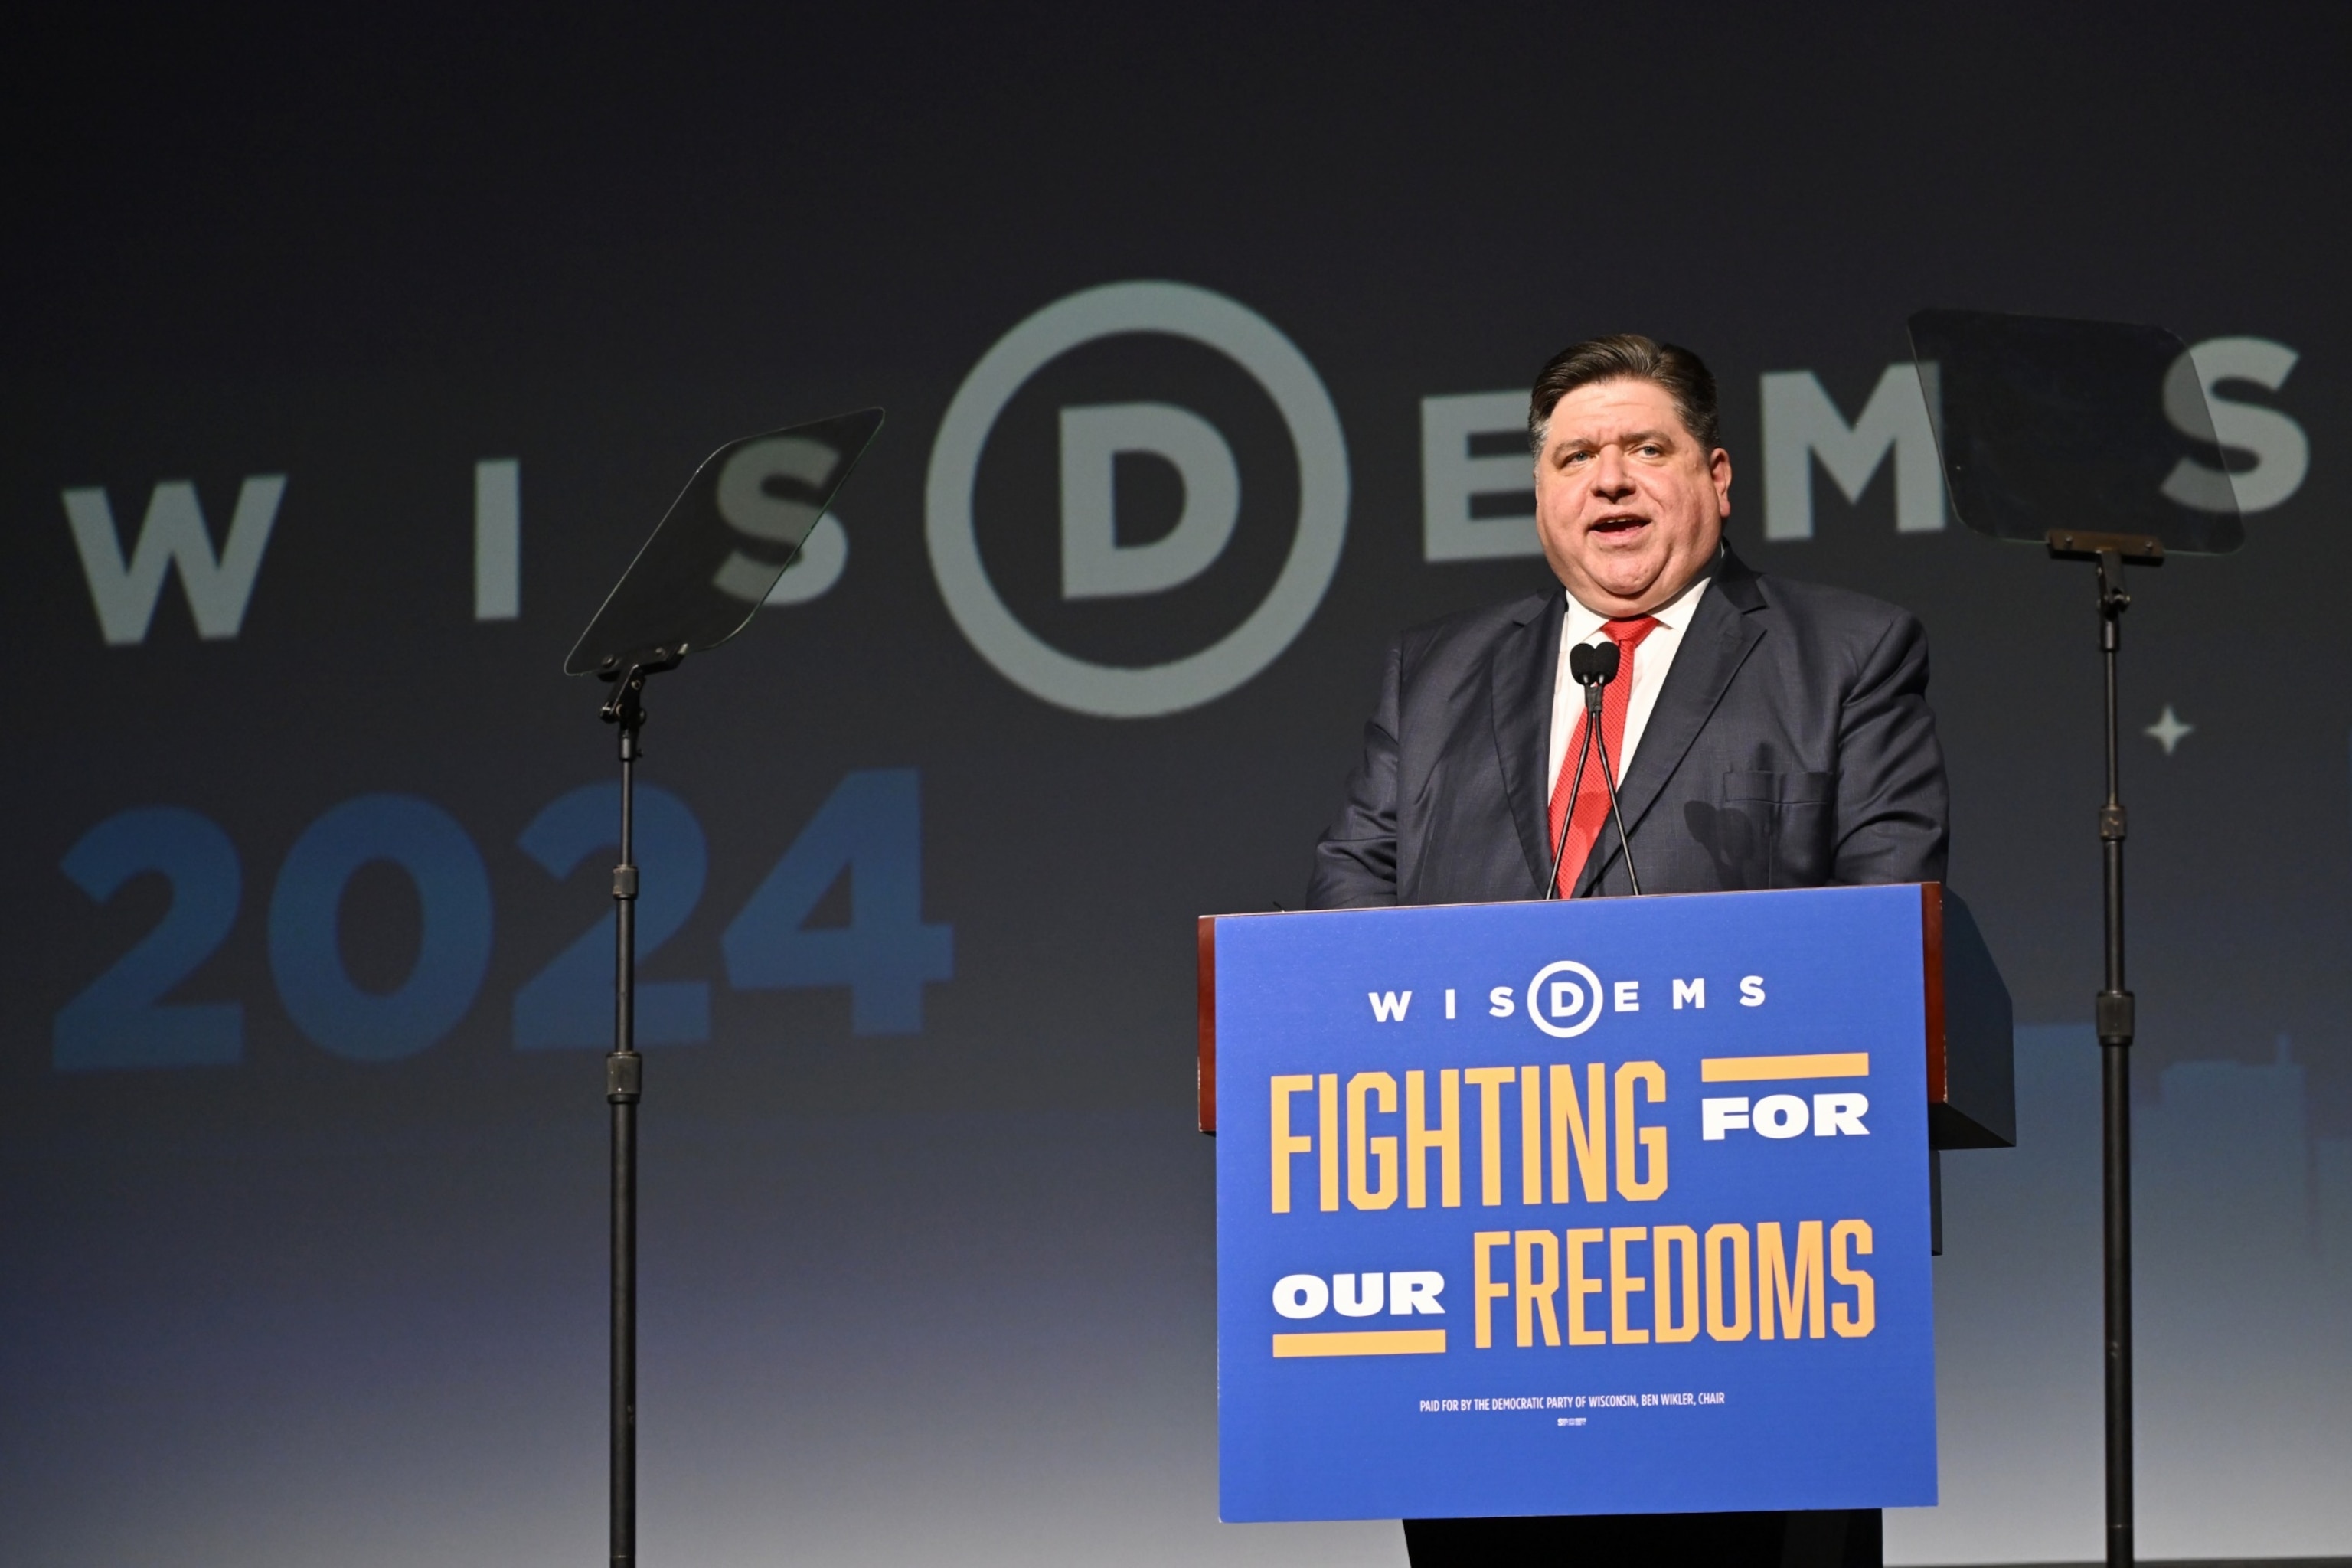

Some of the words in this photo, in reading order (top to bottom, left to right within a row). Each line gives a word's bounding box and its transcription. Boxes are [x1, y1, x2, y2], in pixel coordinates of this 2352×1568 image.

[61, 335, 2311, 646] WISDEMS
[52, 766, 955, 1070] 2024
[1368, 975, 1766, 1023] WISDEMS
[1270, 1060, 1668, 1214] FIGHTING
[1701, 1093, 1870, 1141] FOR
[1272, 1270, 1446, 1319] OUR
[1473, 1219, 1876, 1349] FREEDOMS
[1419, 1400, 1440, 1412] PAID
[1442, 1399, 1459, 1412] FOR
[1460, 1399, 1472, 1411] BY
[1473, 1398, 1490, 1411] THE
[1491, 1396, 1544, 1410] DEMOCRATIC
[1546, 1396, 1573, 1409] PARTY
[1575, 1396, 1586, 1408] OF
[1588, 1394, 1639, 1408] WISCONSIN,
[1641, 1393, 1659, 1406] BEN
[1660, 1393, 1697, 1406] WIKLER,
[1697, 1392, 1725, 1405] CHAIR
